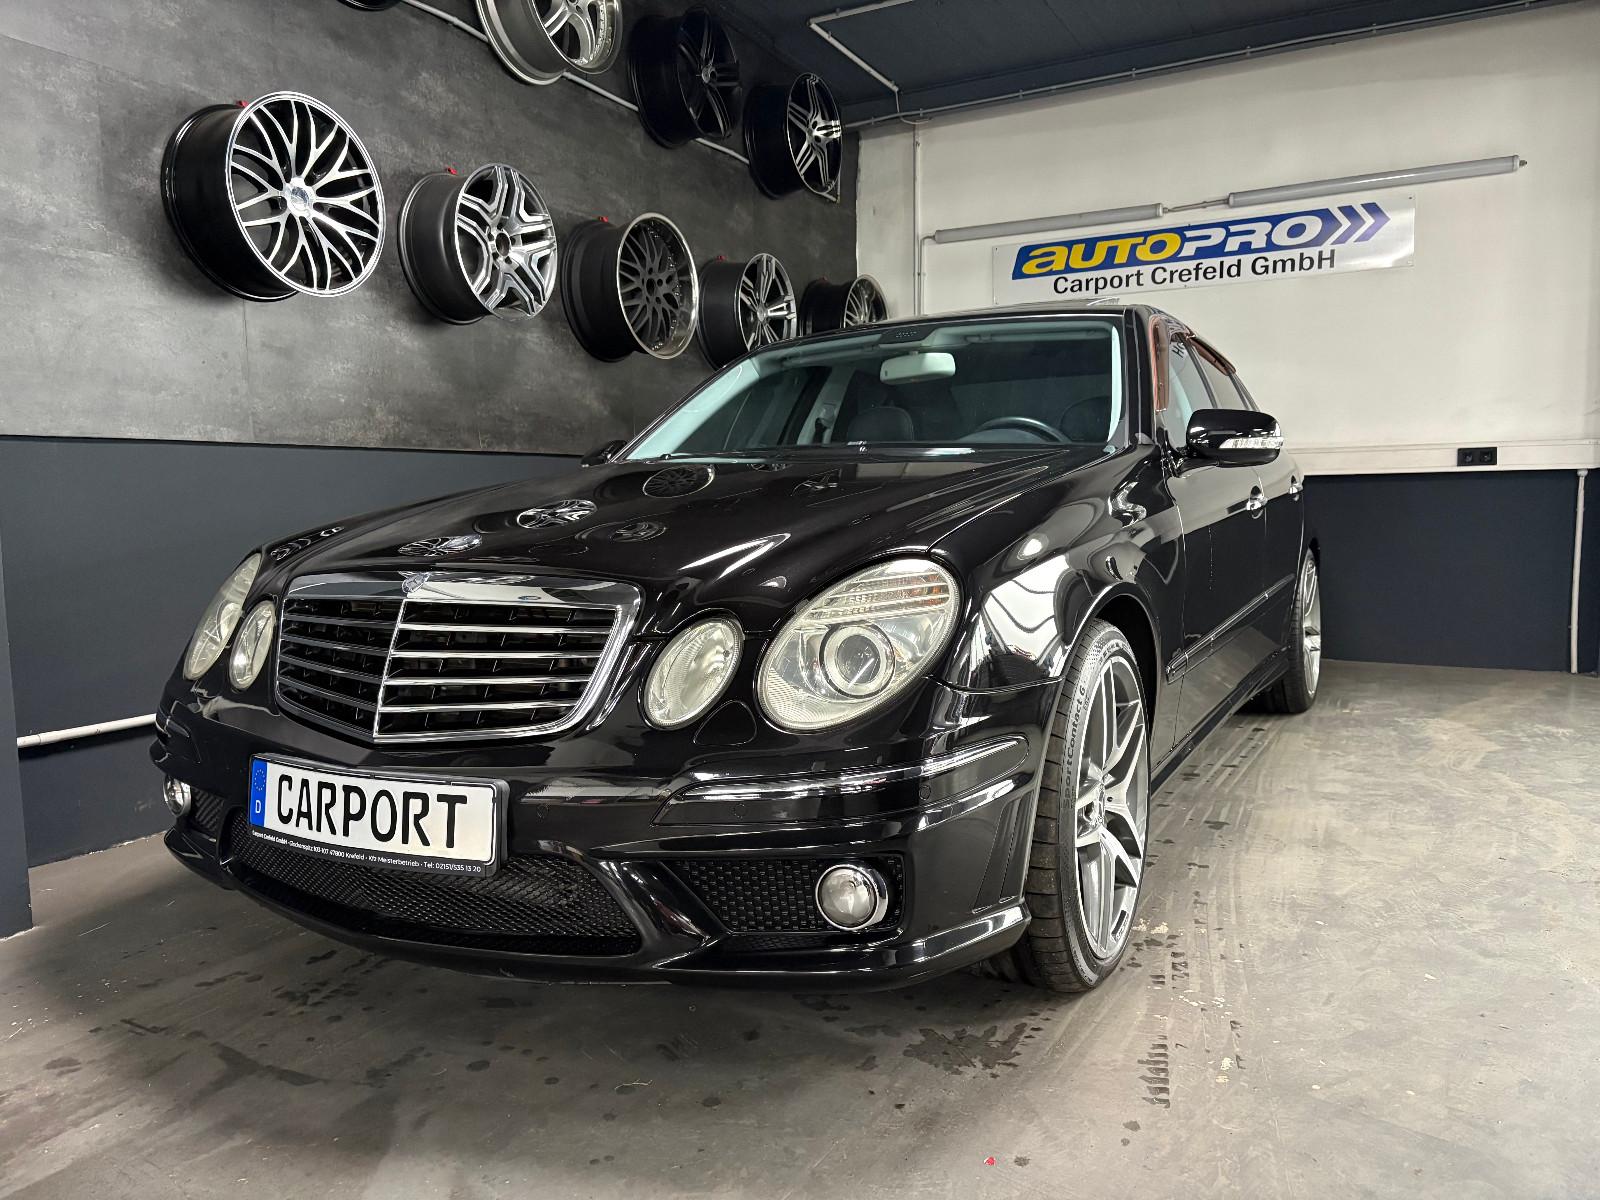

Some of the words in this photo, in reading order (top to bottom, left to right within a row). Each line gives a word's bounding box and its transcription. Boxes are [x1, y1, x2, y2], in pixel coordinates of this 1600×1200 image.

[1053, 268, 1143, 295] Carport
[1150, 259, 1241, 286] Crefeld
[1250, 249, 1336, 276] GmbH
[1060, 698, 1083, 809] SportContact
[255, 800, 262, 814] D
[277, 774, 467, 848] CARPORT
[378, 856, 420, 867] Meisterbetrieb
[424, 861, 434, 869] Tel:
